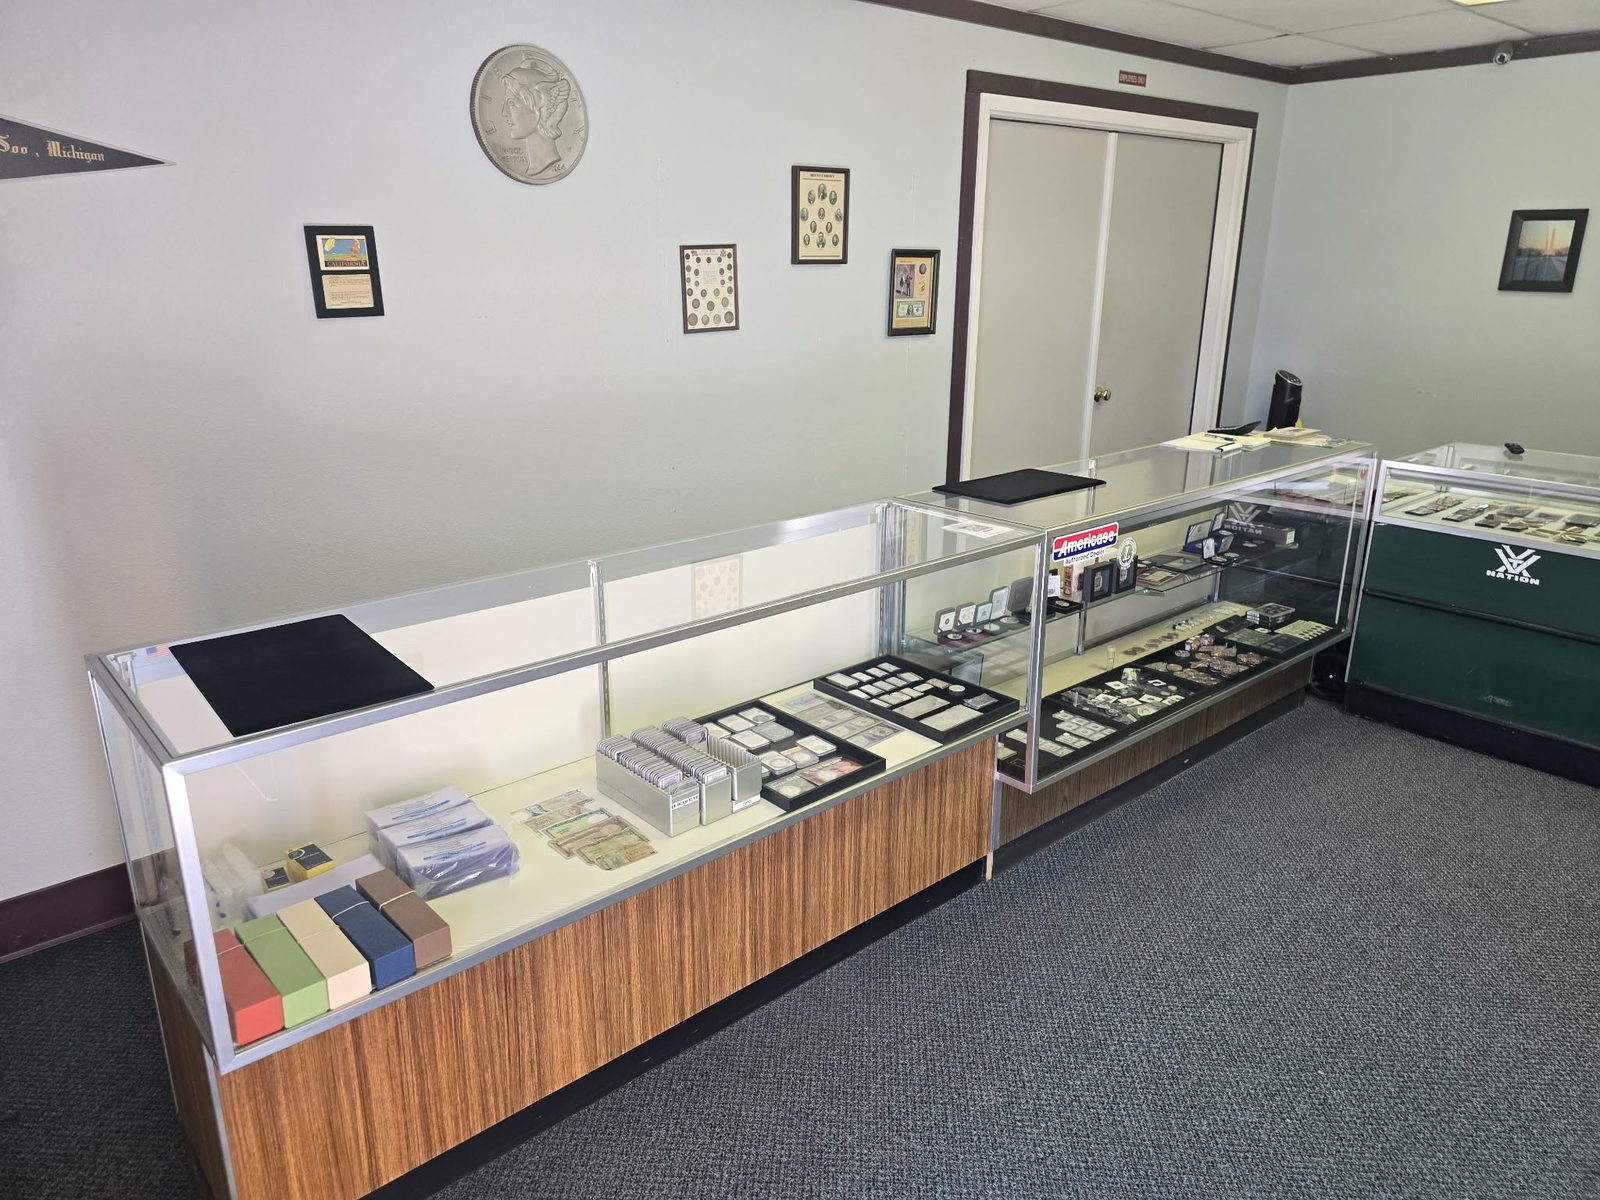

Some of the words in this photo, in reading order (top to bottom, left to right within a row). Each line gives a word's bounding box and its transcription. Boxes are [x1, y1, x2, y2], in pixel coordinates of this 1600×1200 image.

[47, 140, 105, 163] Michigan
[1057, 530, 1116, 558] Americase
[1486, 569, 1540, 586] NATION
